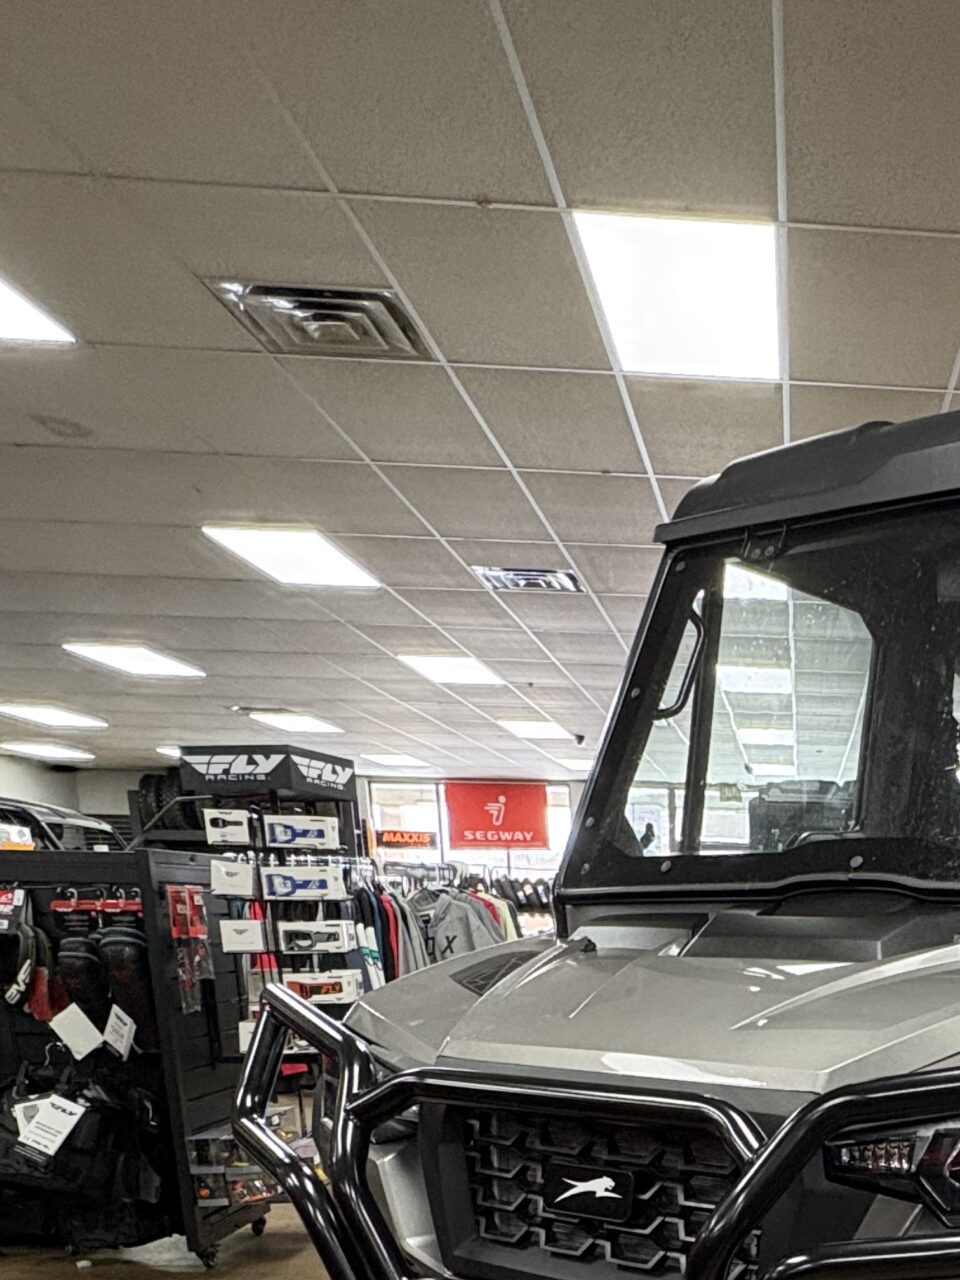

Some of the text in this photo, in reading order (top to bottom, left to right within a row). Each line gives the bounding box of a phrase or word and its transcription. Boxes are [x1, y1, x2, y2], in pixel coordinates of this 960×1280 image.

[183, 754, 287, 775] FLY
[290, 754, 354, 784] FLY
[306, 777, 345, 790] RACING
[382, 831, 430, 843] MAXXIS
[463, 830, 534, 841] SEGWAY
